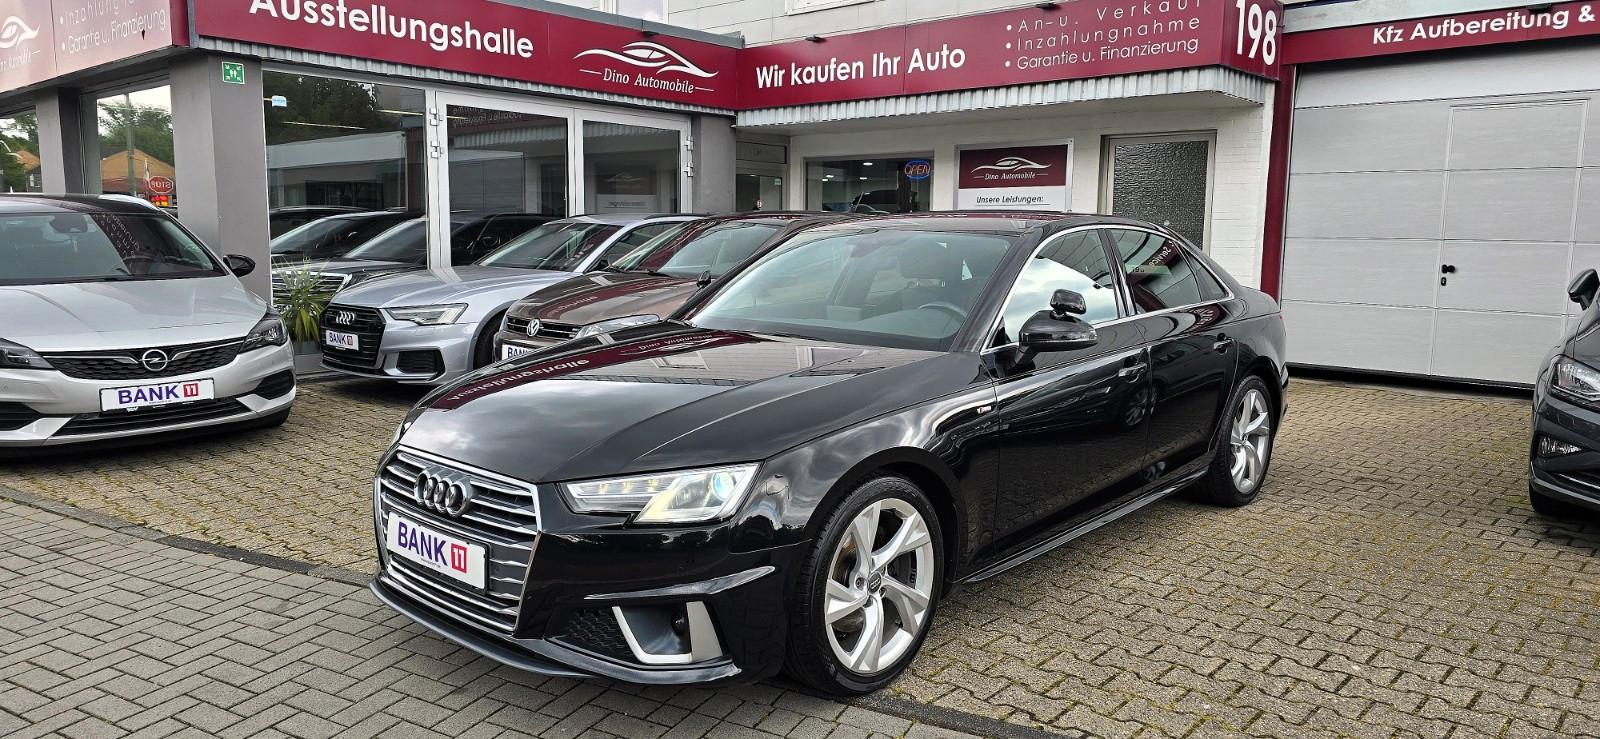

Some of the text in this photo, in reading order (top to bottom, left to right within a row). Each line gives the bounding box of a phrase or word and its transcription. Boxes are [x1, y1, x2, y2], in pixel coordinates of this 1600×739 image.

[111, 8, 166, 40] Finanzierung
[249, 0, 534, 58] Ausstellungshalle
[1017, 16, 1200, 51] Inzahlungnahme
[1235, 0, 1277, 66] 198
[1373, 5, 1595, 45] Kfz Aufbereitung &
[756, 44, 966, 89] Wir kaufen Ihr Auto
[1017, 37, 1199, 70] Garantie u. Finanzierung
[603, 67, 695, 94] Dino Automobile
[904, 164, 928, 175] OPEN
[1001, 171, 1036, 180] Automobile
[976, 195, 1043, 205] Unsere Leistungen:
[329, 332, 346, 345] BANK
[507, 347, 528, 358] BAN
[118, 384, 198, 405] BANK 11
[398, 521, 466, 571] BANK 11
